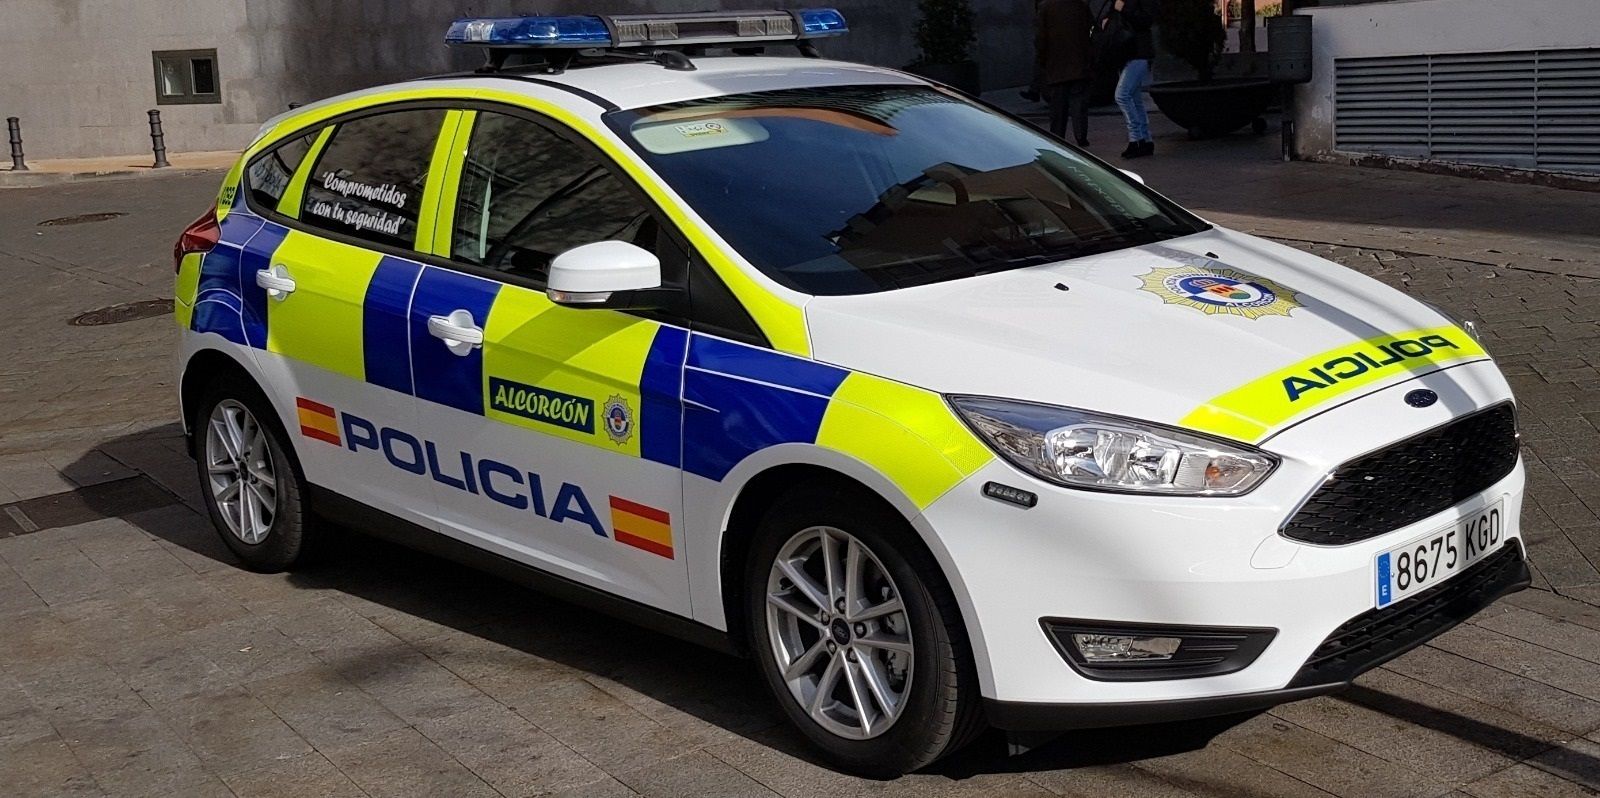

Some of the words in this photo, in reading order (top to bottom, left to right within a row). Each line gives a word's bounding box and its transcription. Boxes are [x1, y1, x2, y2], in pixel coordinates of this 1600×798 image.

[313, 201, 332, 218] con
[332, 202, 343, 220] tu
[495, 384, 589, 426] ALCORCÓN
[340, 411, 609, 539] POLICIA
[1397, 531, 1457, 591] 8675
[1465, 508, 1500, 560] KGD
[1381, 584, 1388, 596] E
